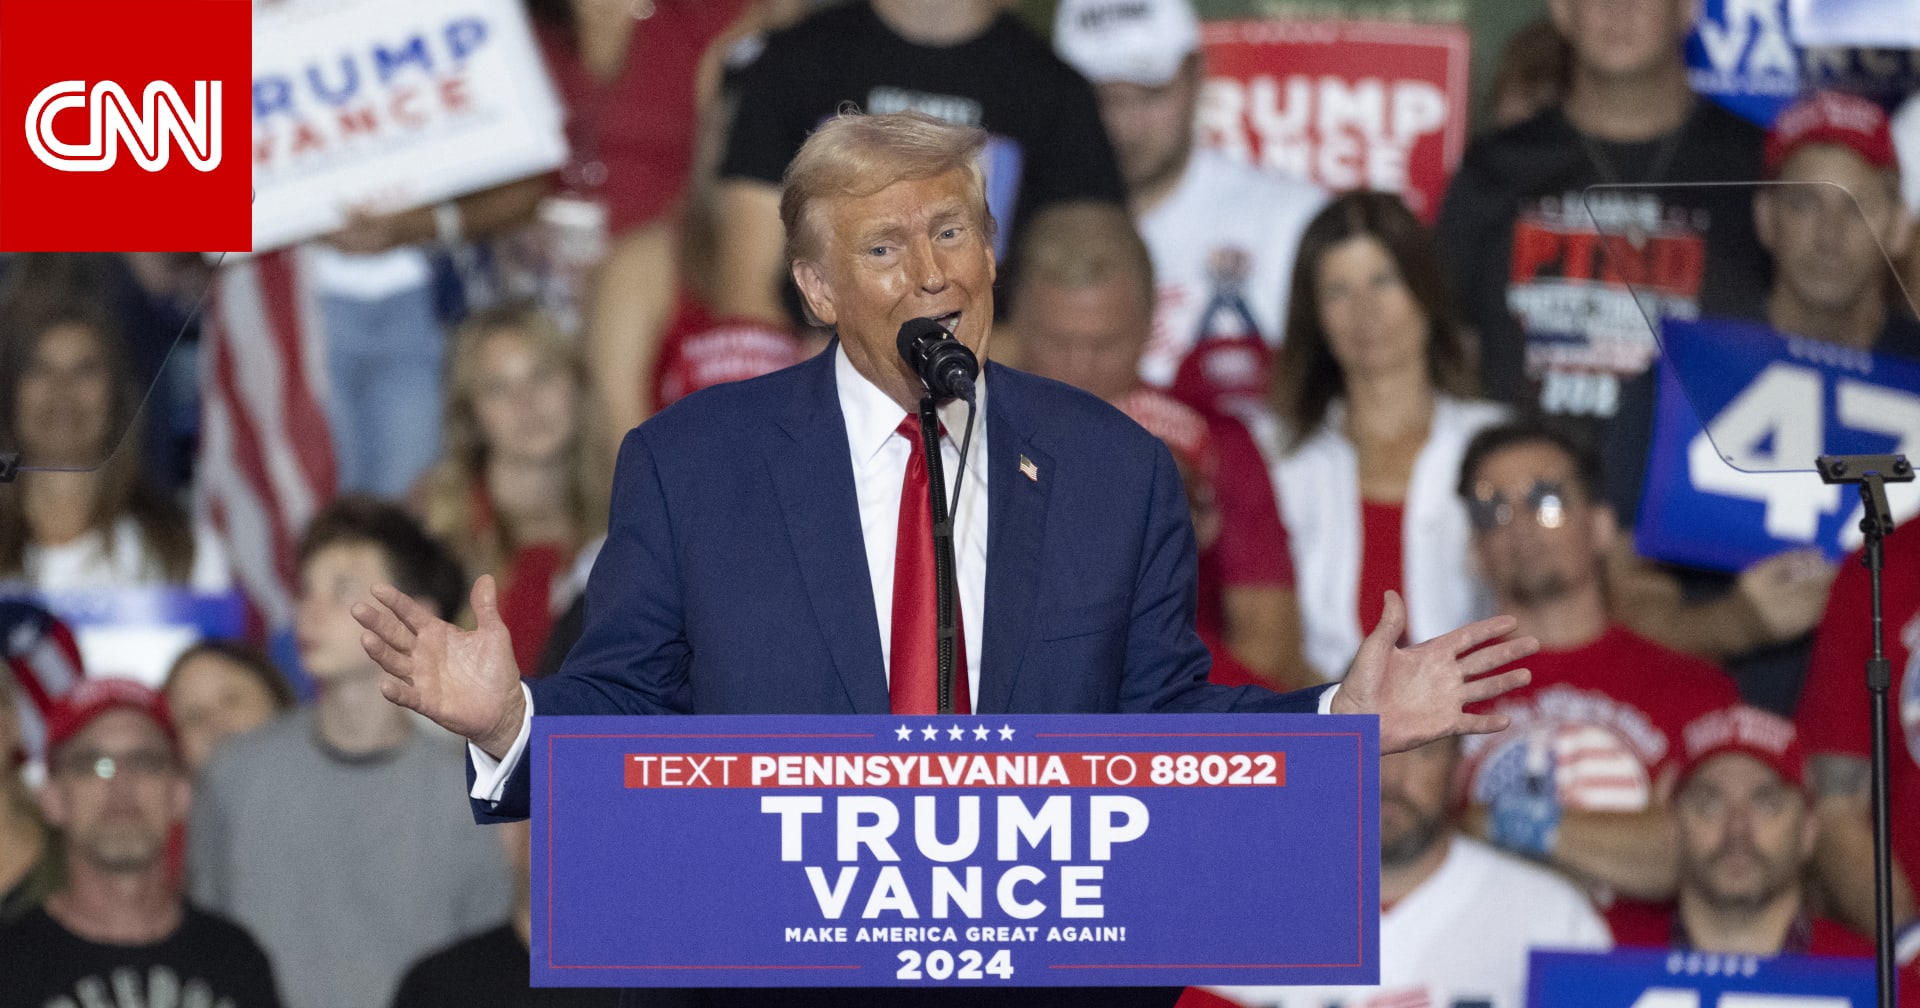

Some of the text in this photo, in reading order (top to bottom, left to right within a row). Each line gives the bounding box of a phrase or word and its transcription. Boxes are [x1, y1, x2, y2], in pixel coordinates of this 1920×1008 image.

[250, 16, 487, 119] RUMP
[1195, 74, 1446, 150] RUMP
[634, 754, 1277, 786] TEXT PENNSYLVANIA TO 88022
[760, 795, 1150, 862] TRUMP
[804, 865, 1104, 919] VANCE
[785, 927, 1126, 942] MAKE AMERICA GREAT AGAIN!
[896, 949, 1014, 981] 2024
